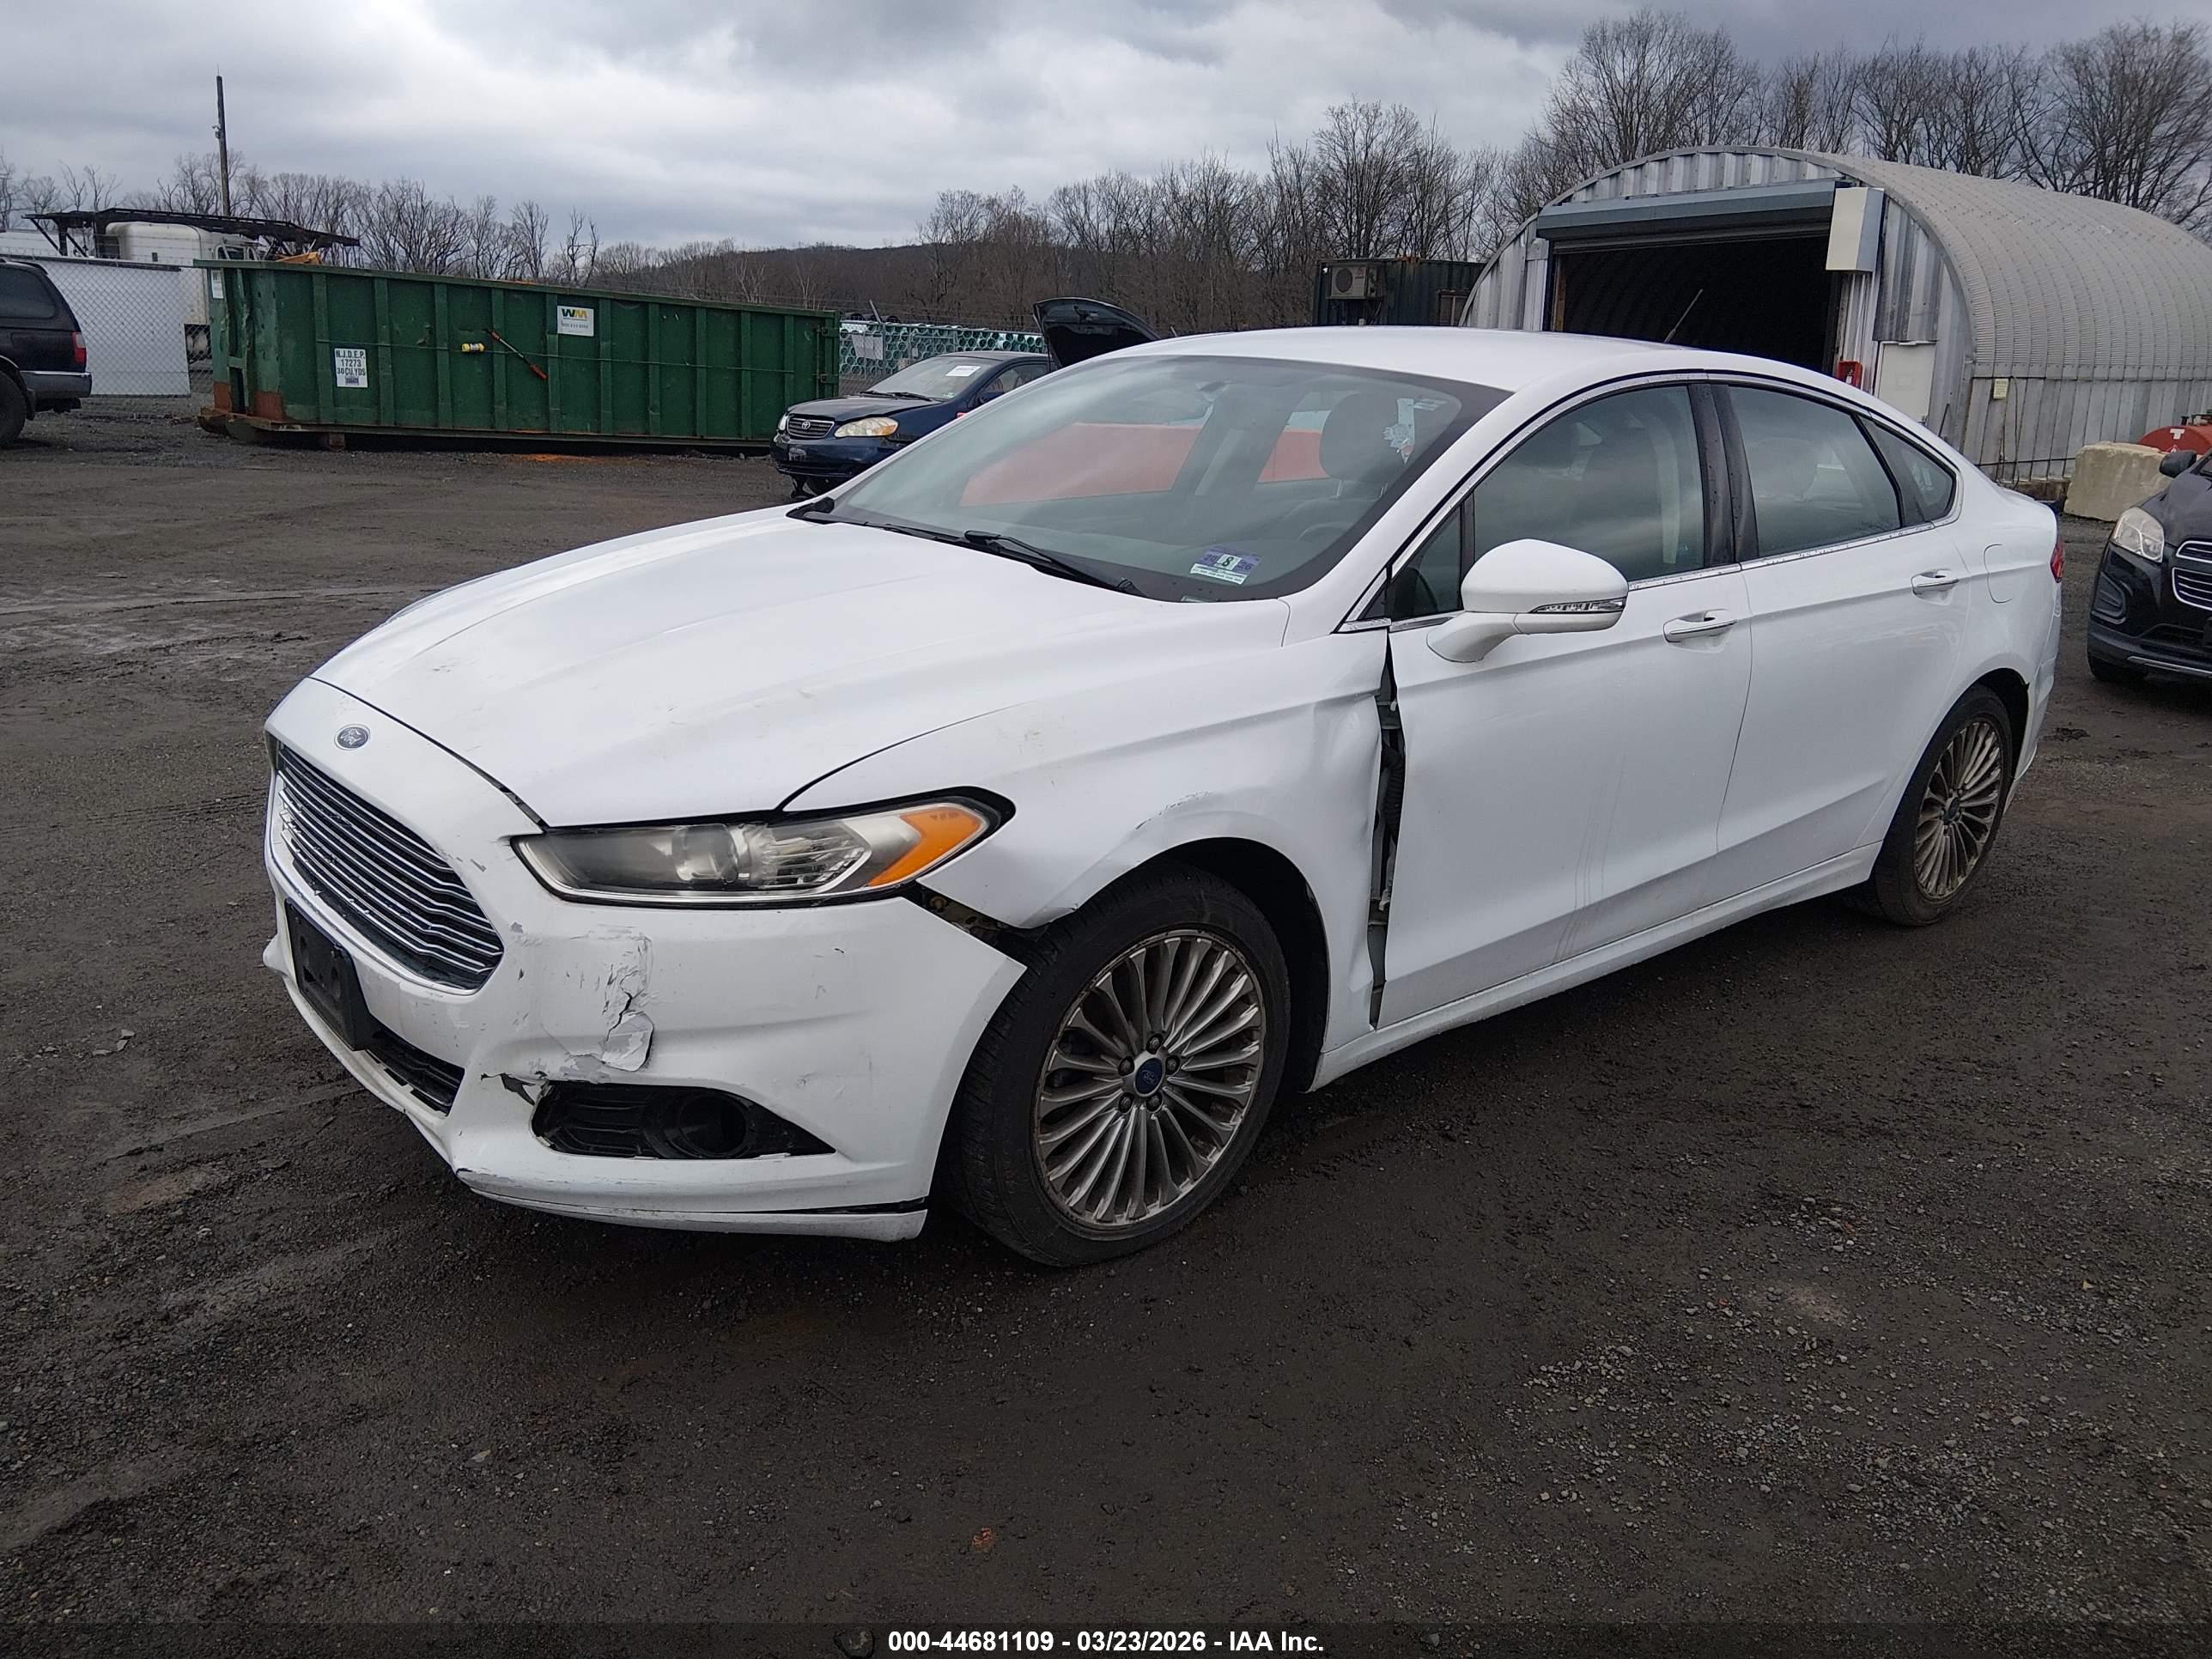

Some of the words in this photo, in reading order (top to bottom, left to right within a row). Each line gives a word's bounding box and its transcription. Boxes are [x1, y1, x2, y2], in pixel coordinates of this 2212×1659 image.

[562, 308, 587, 318] WM
[341, 359, 362, 368] 17273
[1222, 556, 1234, 567] 8
